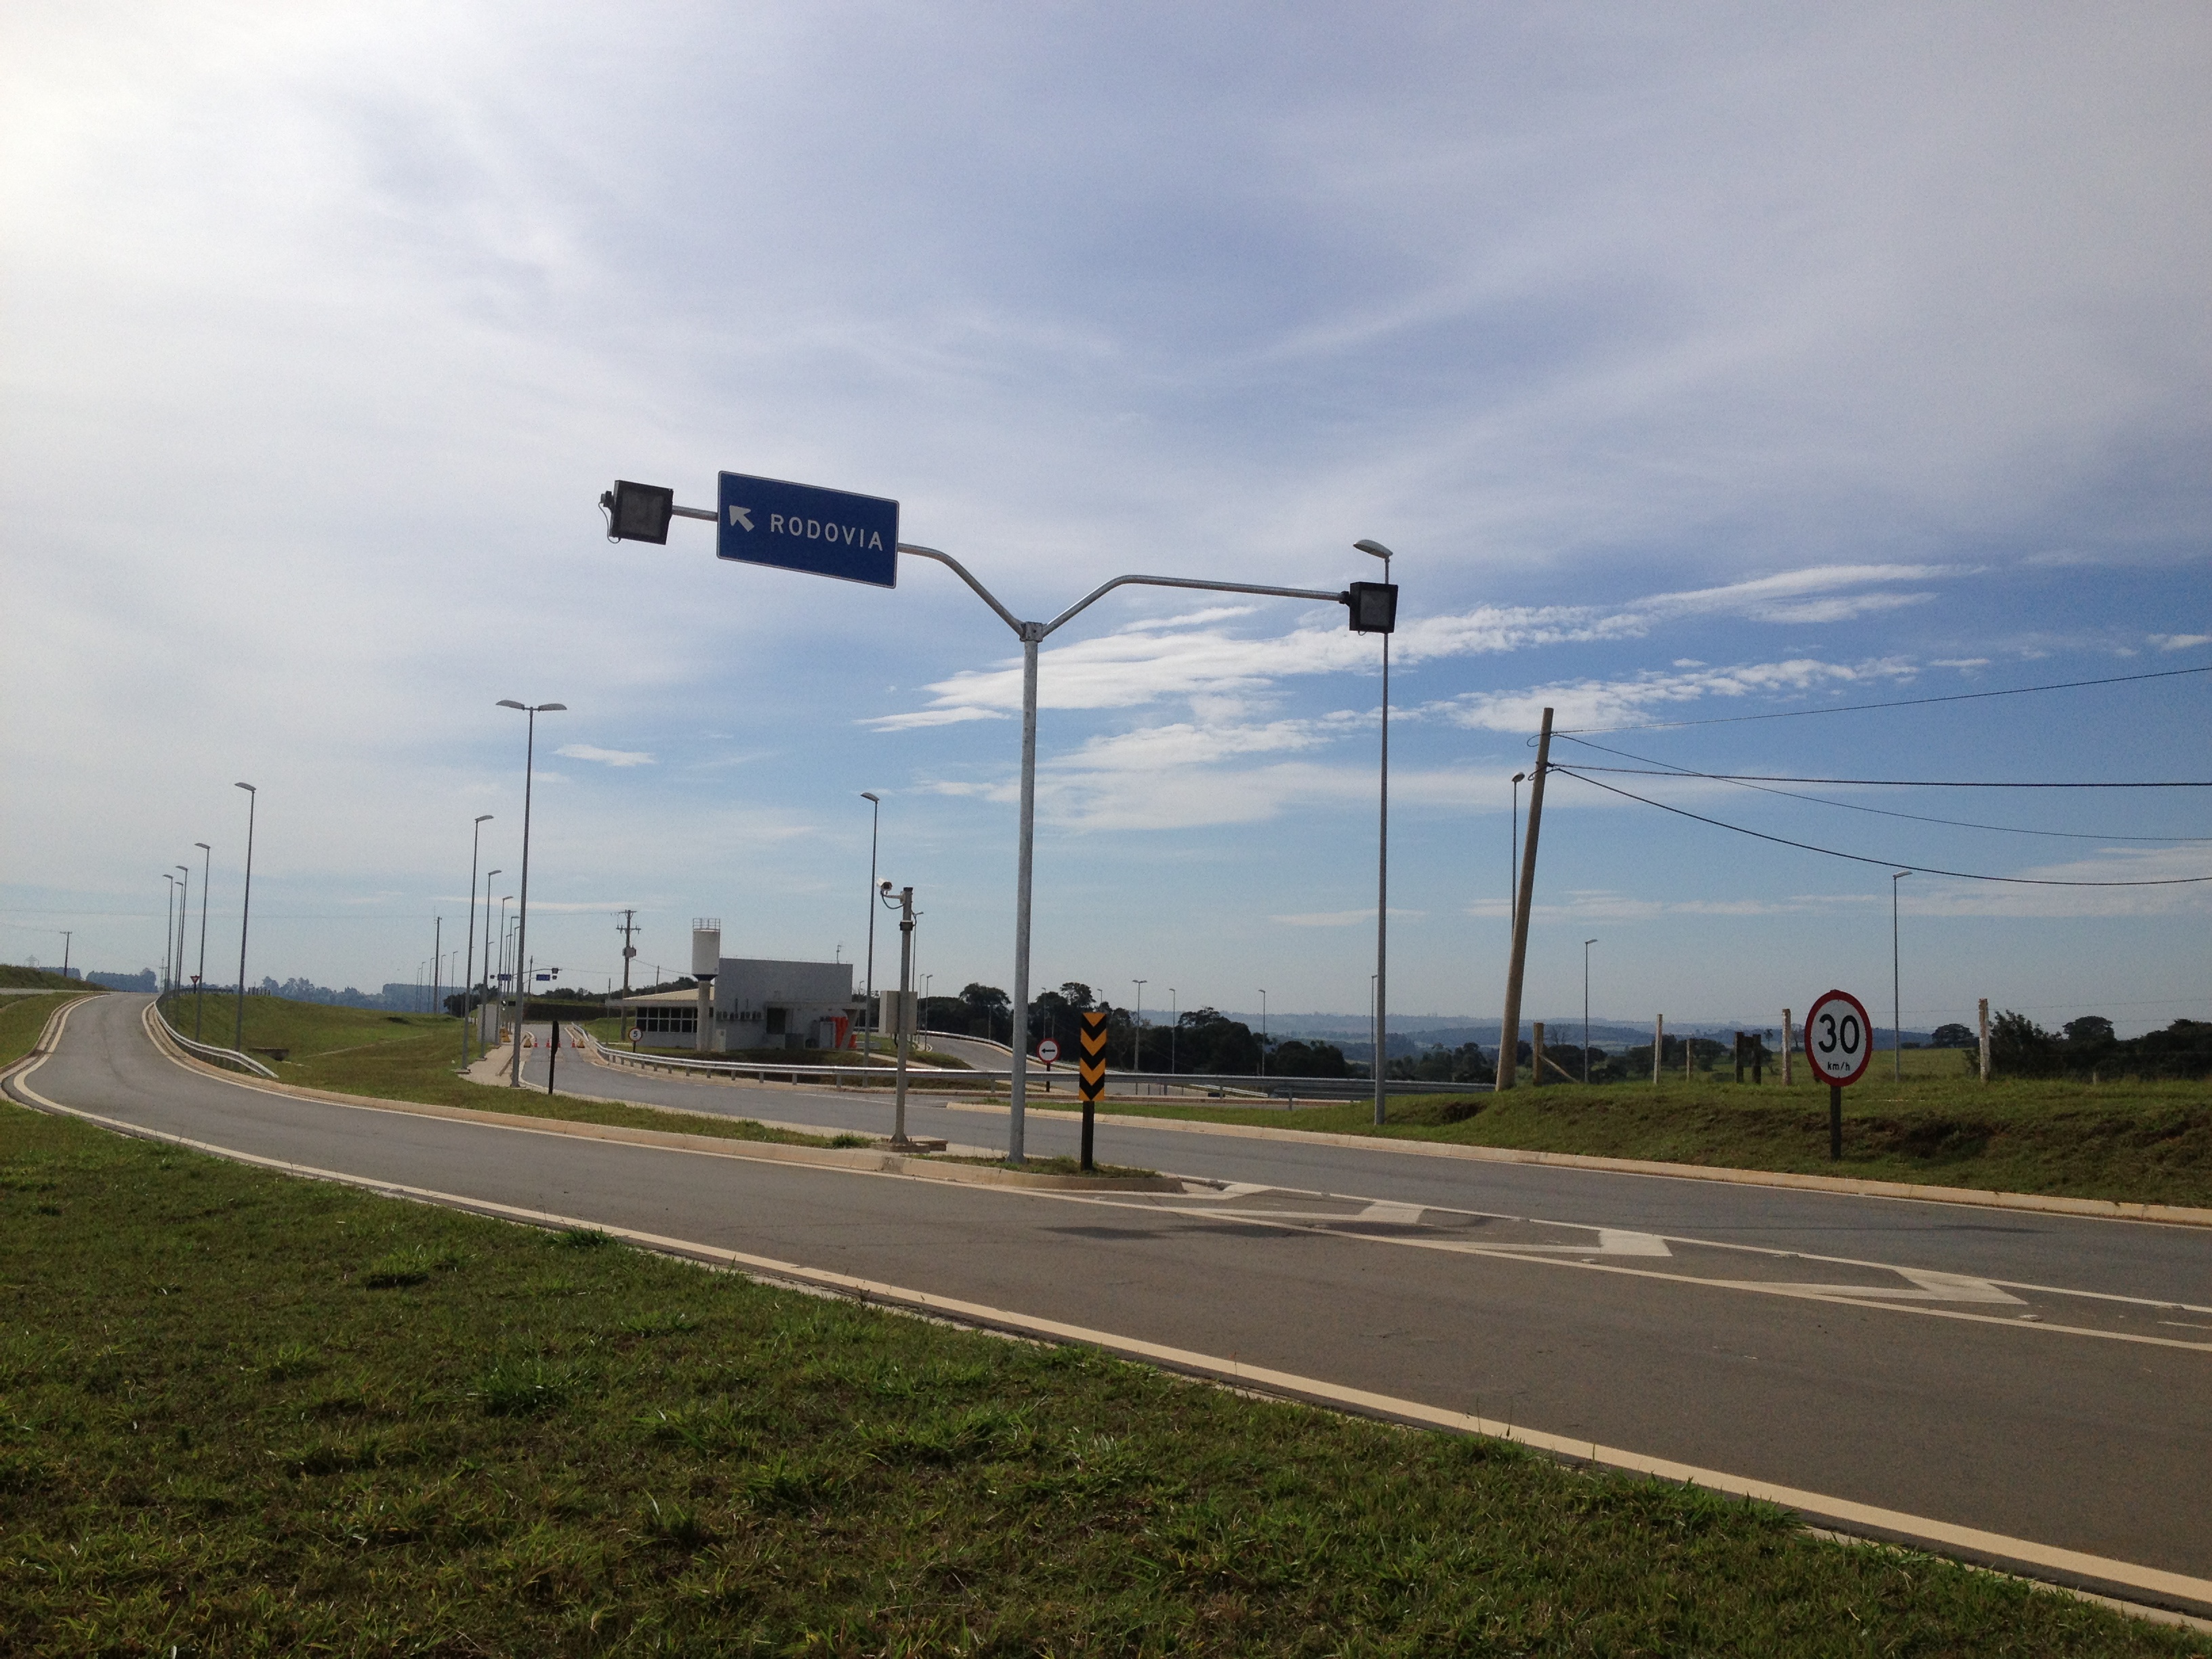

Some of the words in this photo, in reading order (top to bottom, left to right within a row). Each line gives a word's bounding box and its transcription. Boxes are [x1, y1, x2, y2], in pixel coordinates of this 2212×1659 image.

[771, 514, 883, 552] RODOVIA
[1818, 1014, 1860, 1054] 30
[1827, 1061, 1850, 1071] km/h
